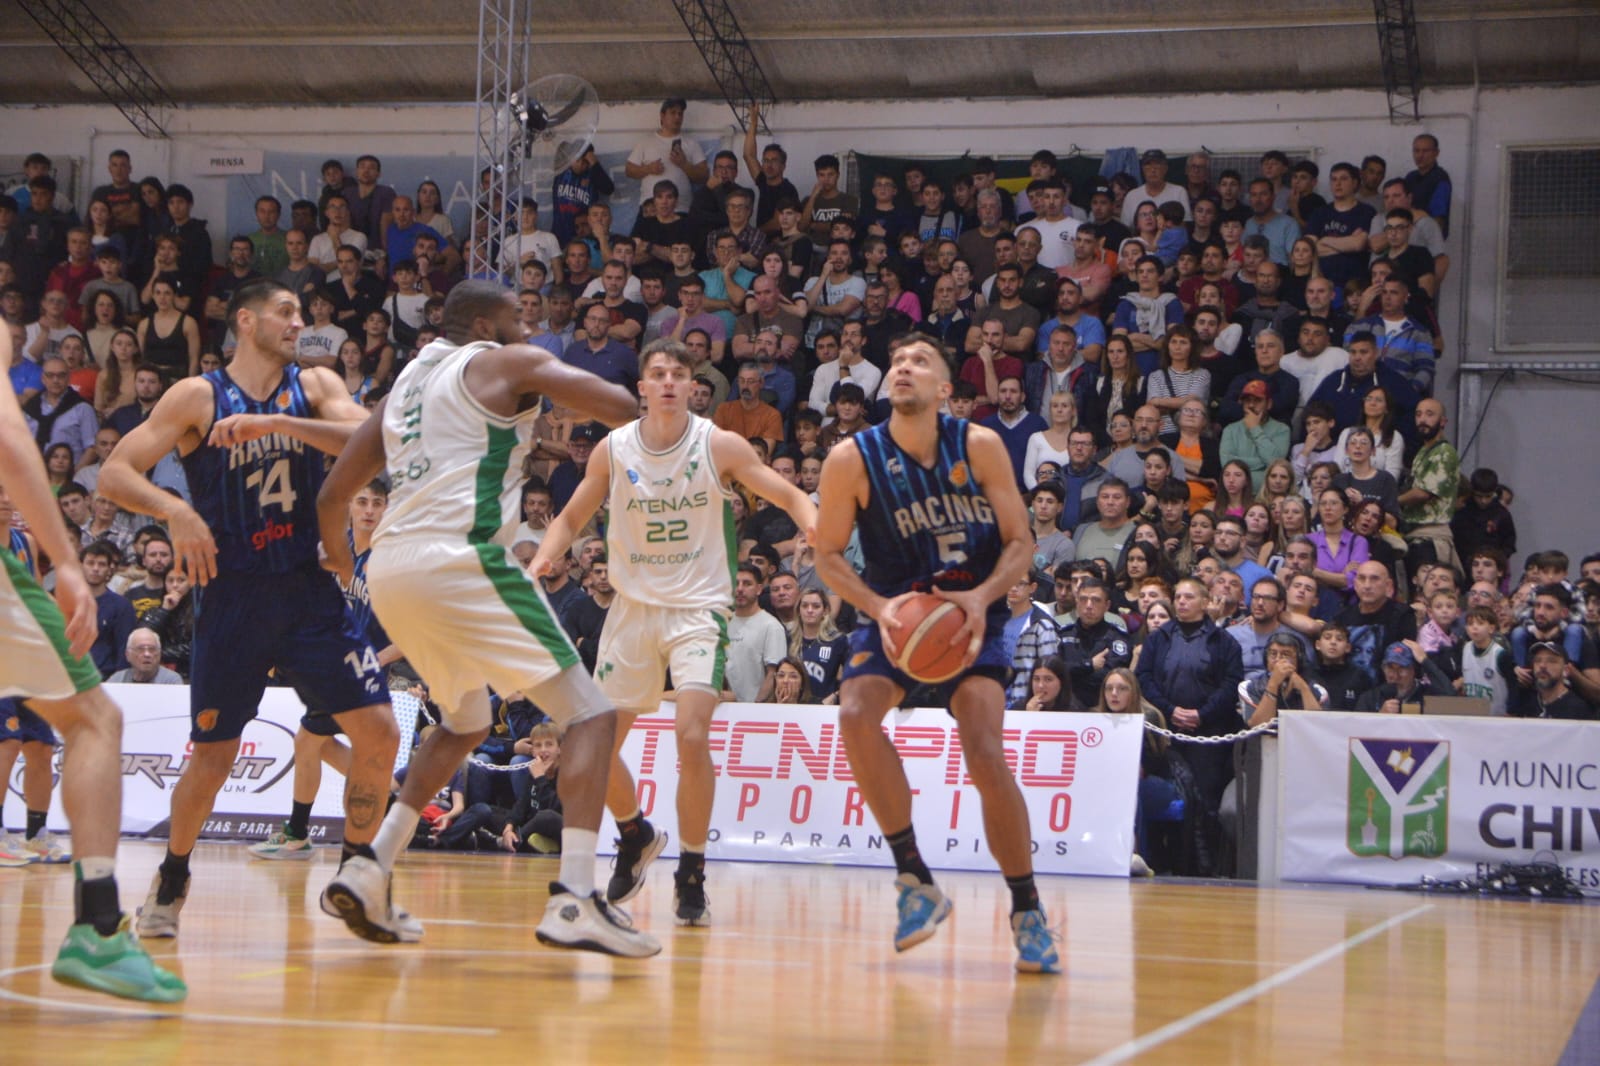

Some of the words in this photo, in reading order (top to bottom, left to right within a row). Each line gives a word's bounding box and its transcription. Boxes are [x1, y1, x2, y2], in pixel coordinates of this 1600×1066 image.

[210, 158, 244, 167] PRENSA
[557, 184, 591, 206] RACING
[246, 458, 297, 518] 14
[626, 491, 709, 514] ATENAS
[894, 493, 995, 539] RACING
[645, 519, 689, 543] 22
[630, 553, 666, 565] BANCO
[935, 531, 968, 568] 5
[343, 645, 381, 679] 14
[1479, 759, 1598, 791] MUNIC
[635, 778, 1073, 833] DPORIO
[238, 821, 273, 835] PARA
[753, 829, 883, 851] PARAN
[946, 837, 1069, 857] PIOS
